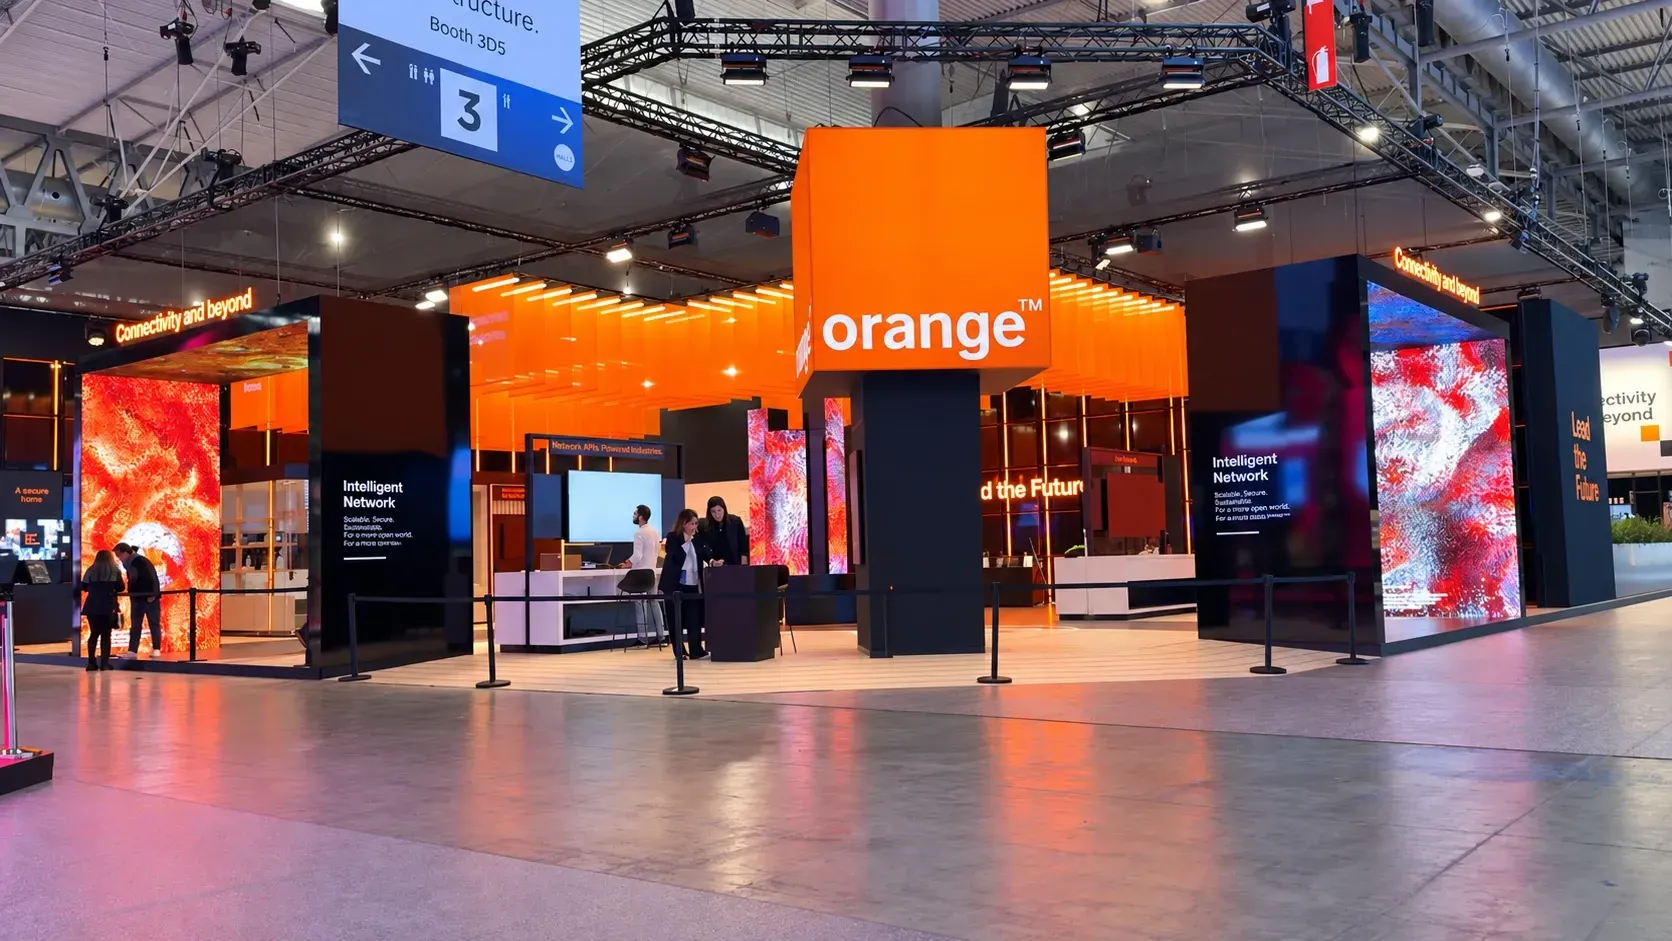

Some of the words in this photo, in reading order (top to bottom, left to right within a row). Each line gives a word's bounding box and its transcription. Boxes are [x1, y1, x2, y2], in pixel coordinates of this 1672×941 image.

[430, 15, 473, 44] Booth
[477, 34, 506, 55] 3D5
[457, 88, 481, 132] 3
[1395, 246, 1442, 292] Connectivity
[1442, 274, 1456, 293] and
[1456, 276, 1479, 304] beyond
[115, 310, 182, 343] Connectivity
[183, 301, 205, 326] and
[207, 286, 252, 320] beyond
[822, 310, 1026, 361] orange
[1571, 411, 1591, 441] Lead
[1212, 453, 1278, 468] Intelligent
[1573, 443, 1587, 470] the
[343, 480, 404, 495] Intelligent
[996, 480, 1027, 499] the
[1213, 469, 1269, 484] Network
[1575, 474, 1600, 502] Future
[343, 496, 396, 508] Network
